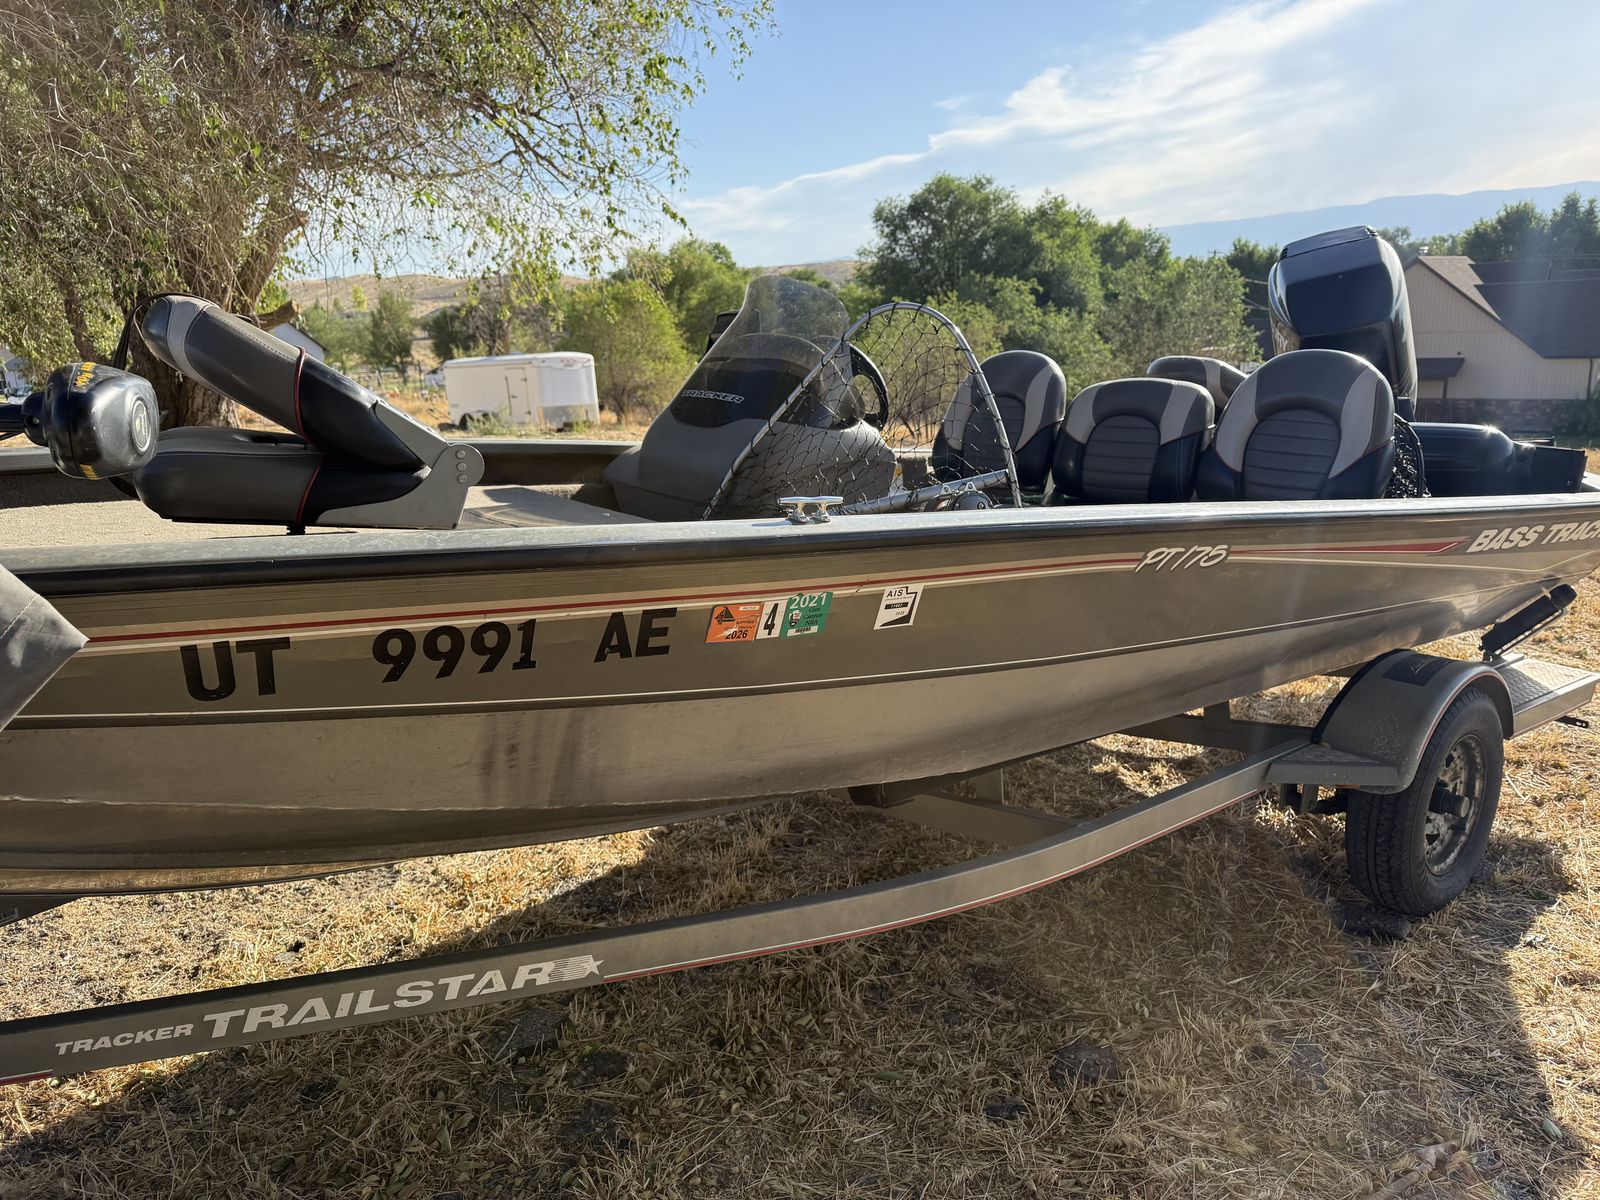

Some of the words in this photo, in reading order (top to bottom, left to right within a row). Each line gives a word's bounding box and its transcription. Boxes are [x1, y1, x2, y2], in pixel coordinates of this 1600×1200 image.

[681, 389, 745, 404] TRACKER
[1466, 524, 1545, 553] BASS
[789, 592, 828, 610] 2021
[886, 589, 903, 598] AIS
[763, 602, 779, 636] 4
[724, 629, 749, 640] 2026
[180, 637, 291, 702] UT
[372, 618, 537, 684] 9991
[594, 607, 678, 663] AE
[54, 1023, 194, 1056] TRACKER
[203, 960, 556, 1039] TRAILSTAR
